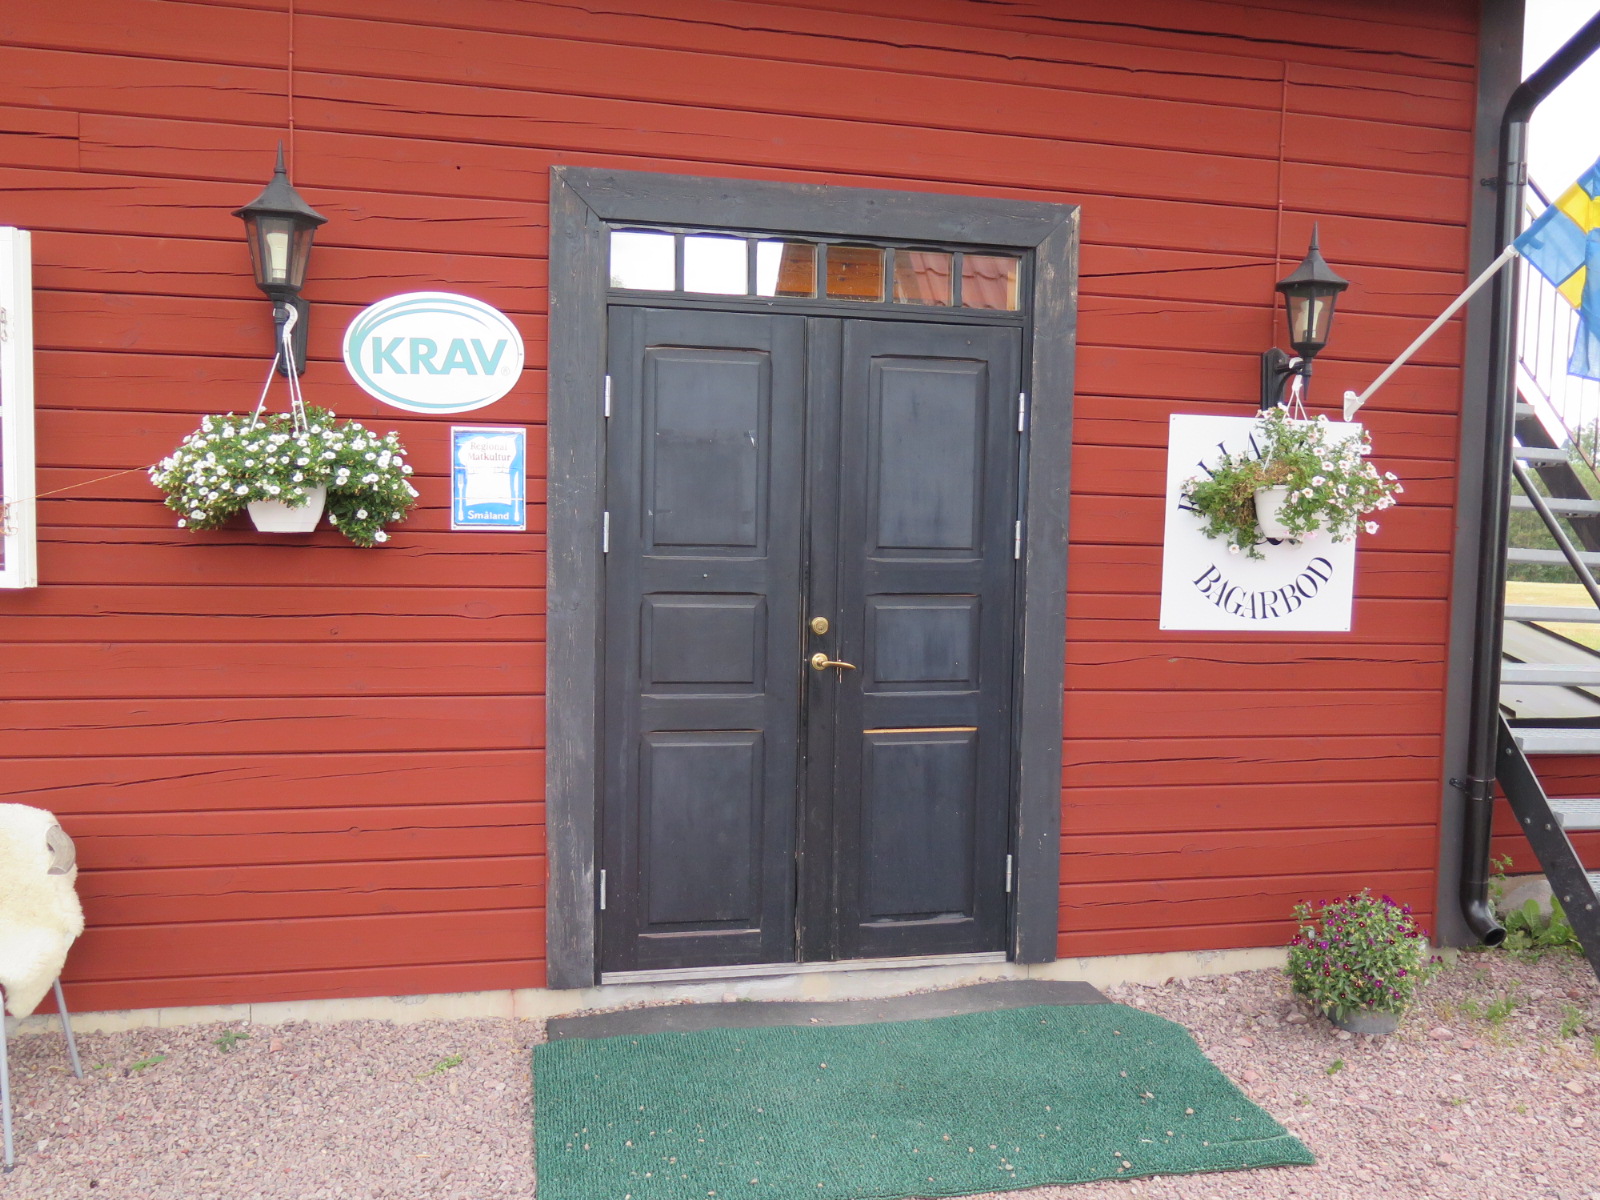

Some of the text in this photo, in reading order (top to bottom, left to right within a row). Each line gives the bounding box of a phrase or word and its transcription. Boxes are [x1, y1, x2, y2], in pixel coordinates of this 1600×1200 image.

[371, 336, 508, 376] KRAV
[469, 441, 508, 452] Regional
[467, 452, 511, 461] Matkultur
[467, 510, 510, 520] Småland
[1192, 556, 1333, 619] BAGARBOD
